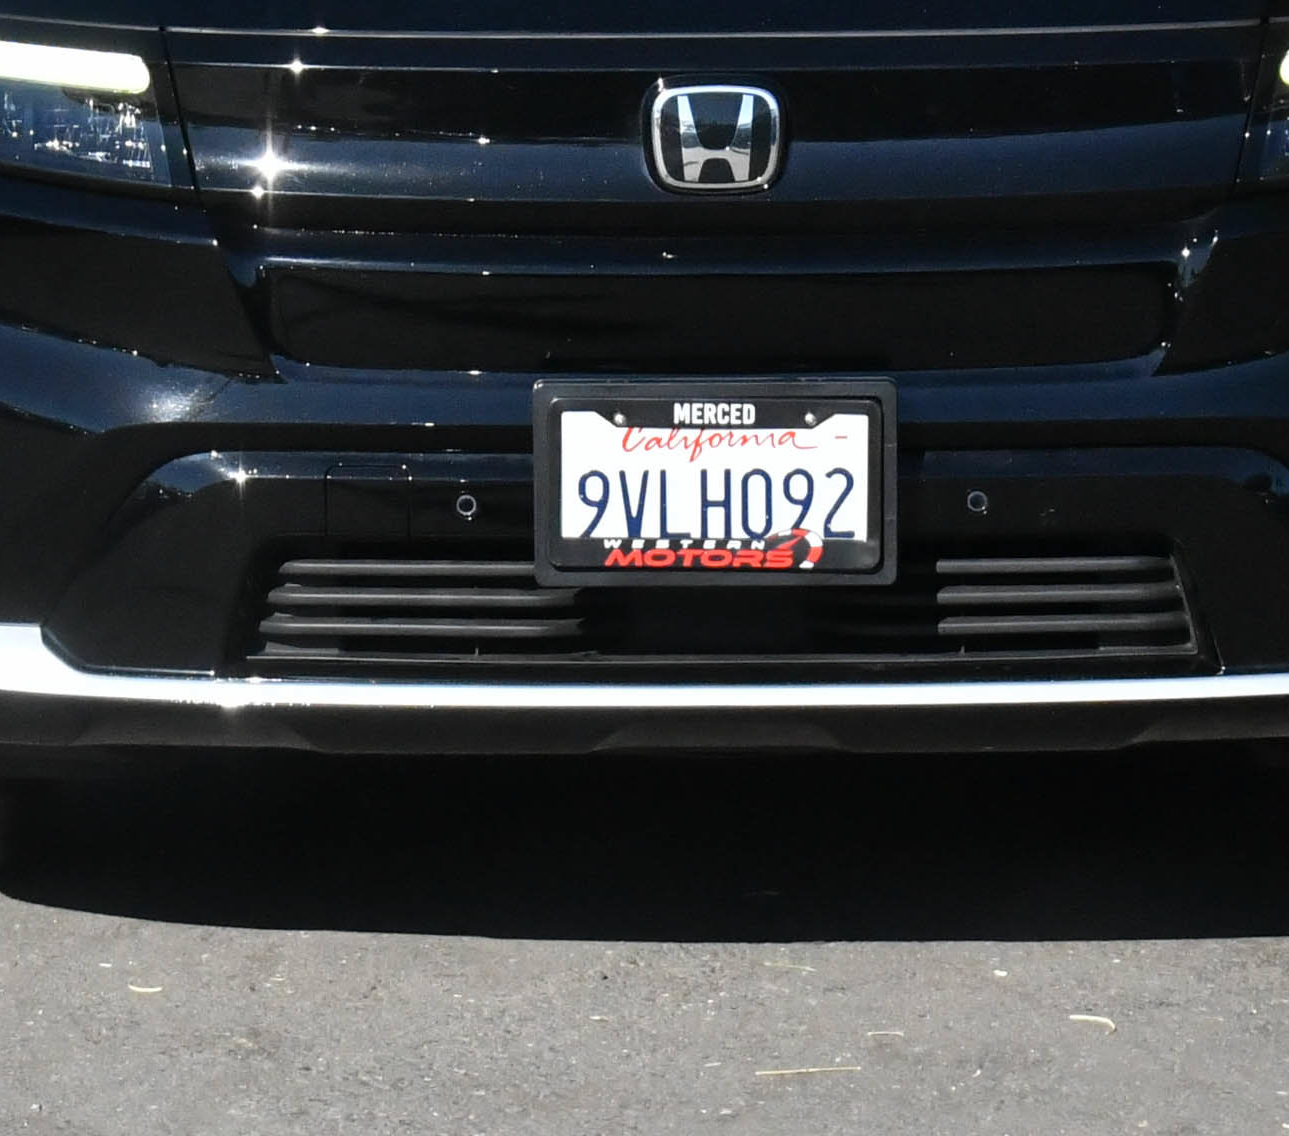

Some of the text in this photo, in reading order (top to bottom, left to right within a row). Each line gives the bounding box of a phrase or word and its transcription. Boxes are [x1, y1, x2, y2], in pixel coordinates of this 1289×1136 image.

[673, 402, 756, 425] MERCED
[621, 426, 819, 463] California
[578, 467, 855, 540] 9VLH092
[603, 538, 766, 550] WESTERN
[604, 548, 794, 569] MOTORS
